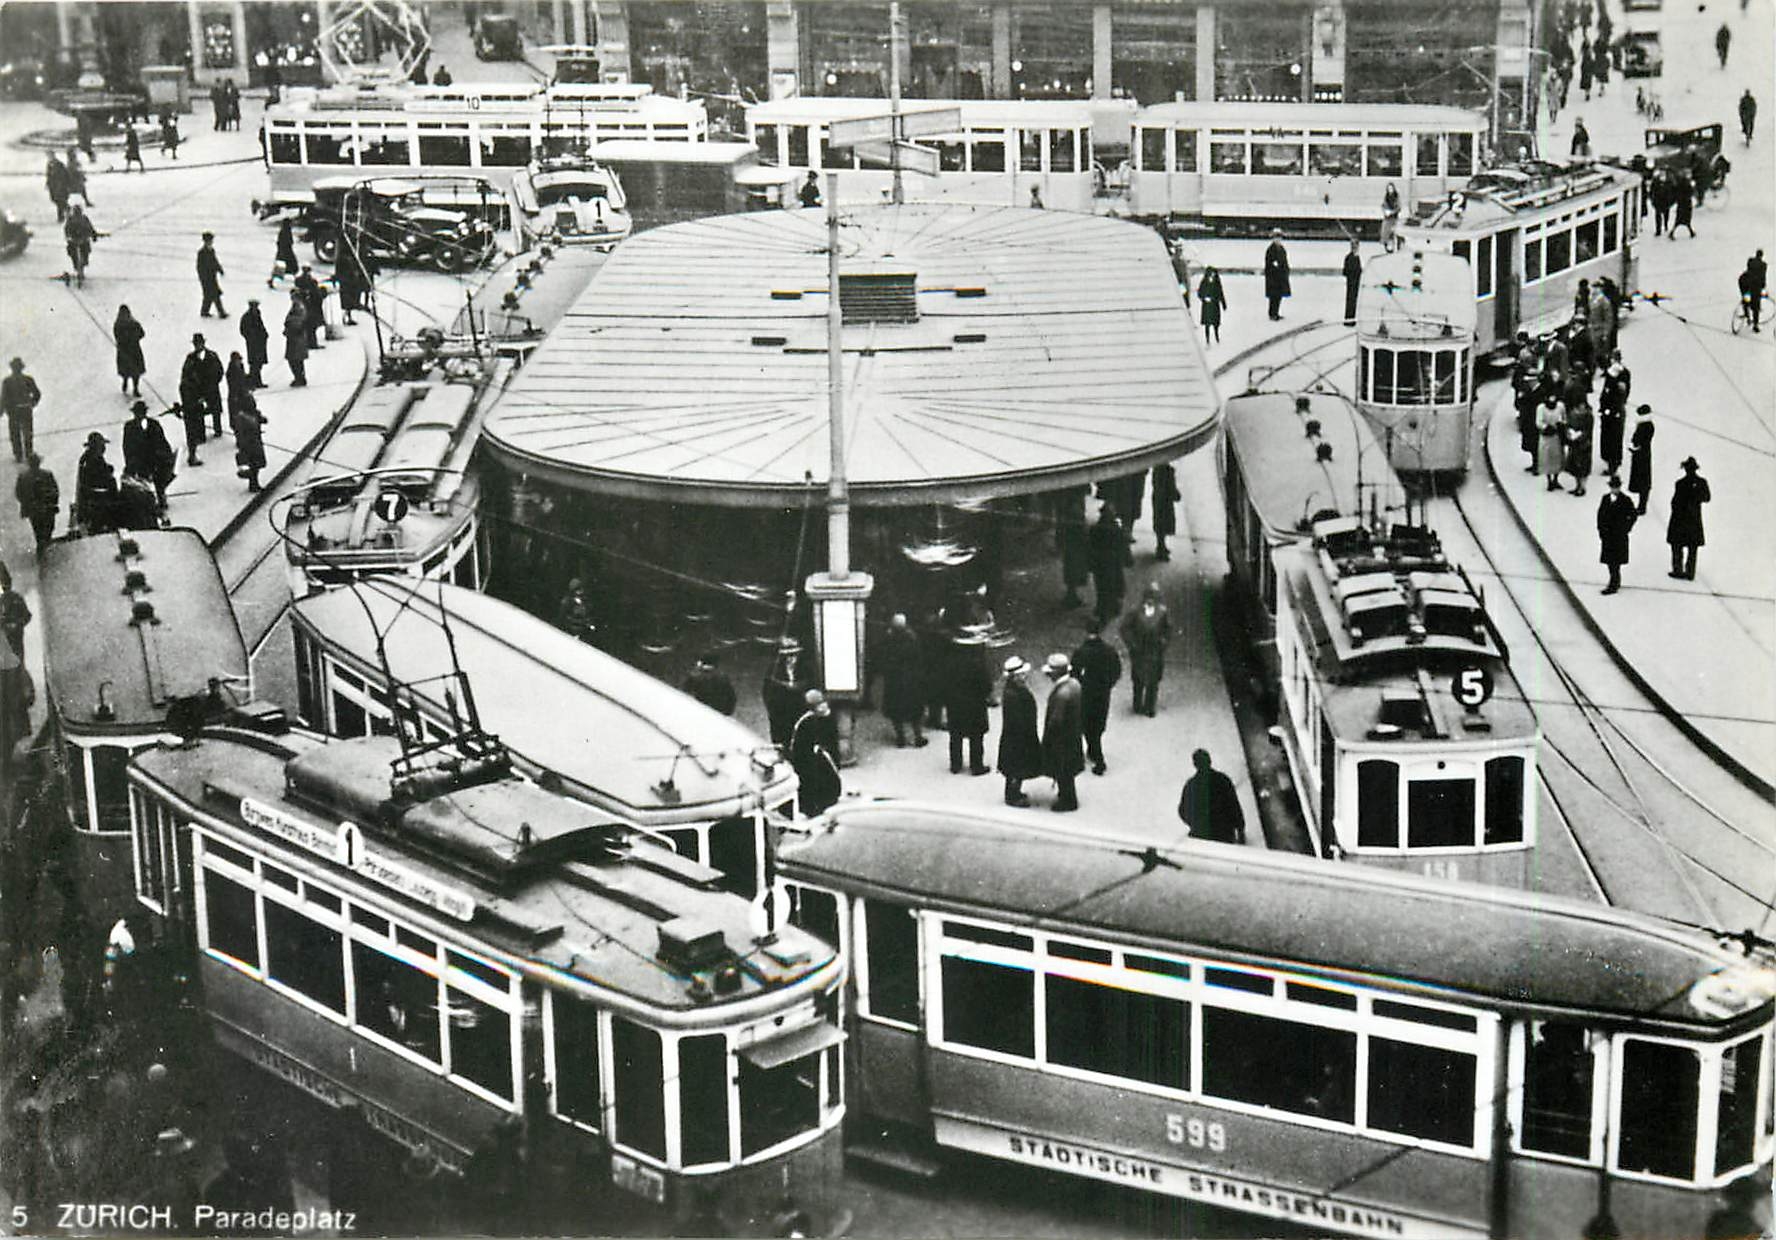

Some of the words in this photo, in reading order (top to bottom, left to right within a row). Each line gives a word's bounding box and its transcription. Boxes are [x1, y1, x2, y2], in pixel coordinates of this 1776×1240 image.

[466, 96, 480, 110] 10
[595, 200, 601, 217] 1
[1451, 192, 1464, 212] 2
[382, 494, 399, 520] 7
[1462, 669, 1484, 704] 5
[345, 828, 353, 866] 1
[763, 890, 774, 931] 1
[1166, 1113, 1226, 1152] 599
[1189, 1176, 1404, 1235] STRASSENBAHN
